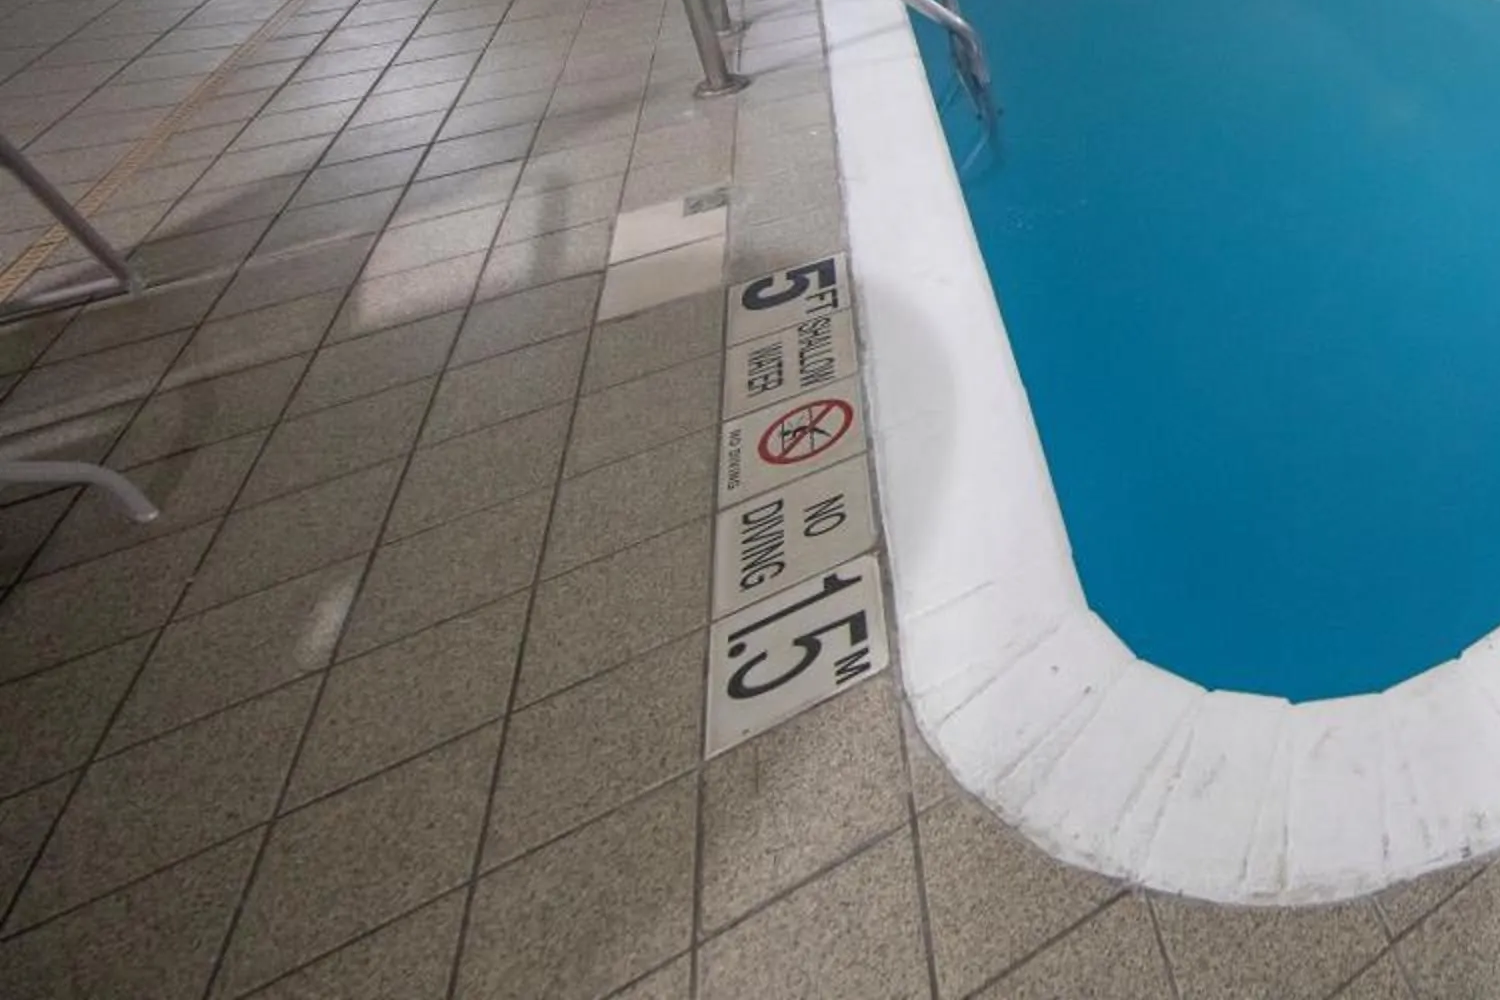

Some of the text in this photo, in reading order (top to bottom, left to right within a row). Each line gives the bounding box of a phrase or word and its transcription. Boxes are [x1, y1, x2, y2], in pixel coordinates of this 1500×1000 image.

[742, 258, 838, 314] 5 FT
[746, 341, 783, 397] WATER
[798, 316, 836, 387] SHALLOW
[727, 429, 741, 491] NO DIVING
[740, 498, 785, 592] DIVING
[804, 493, 846, 537] NO
[728, 573, 870, 700] 1.5 M
